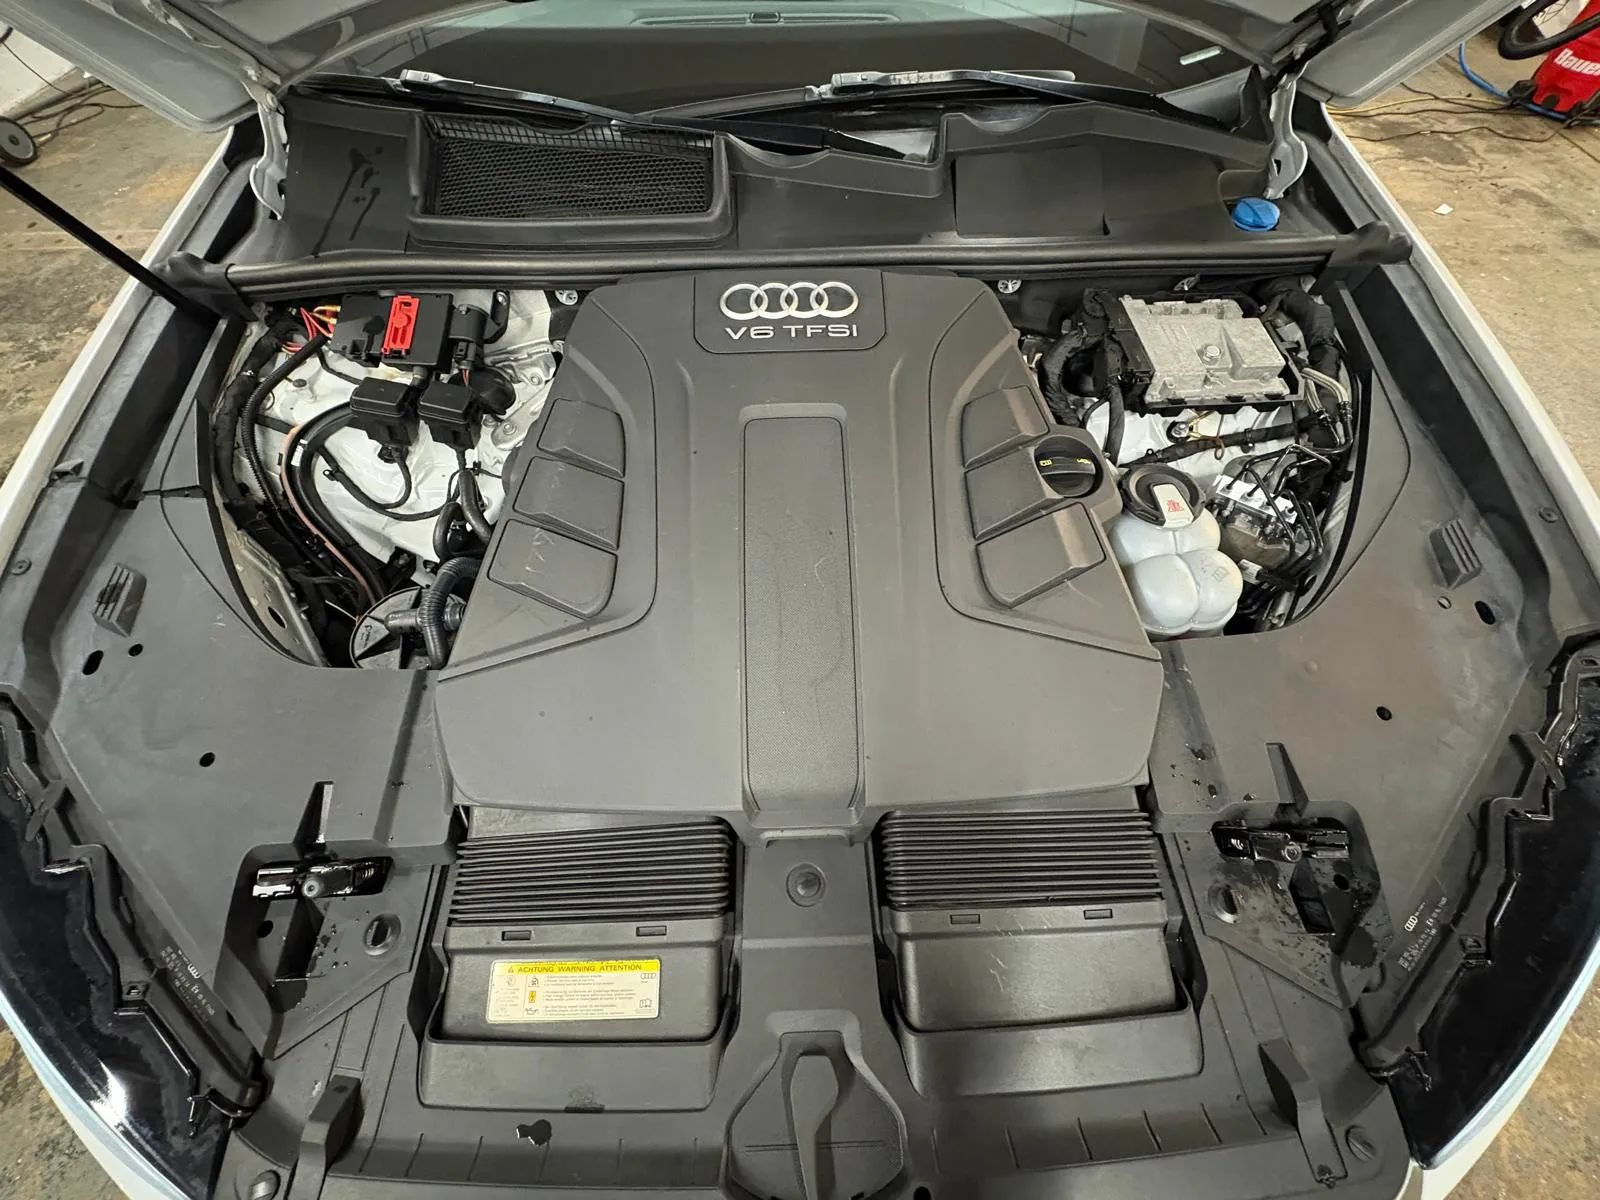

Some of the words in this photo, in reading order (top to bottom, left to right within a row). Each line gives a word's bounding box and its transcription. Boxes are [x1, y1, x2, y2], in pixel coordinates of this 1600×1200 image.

[724, 325, 775, 340] V6
[782, 323, 858, 338] TFSI
[518, 965, 554, 973] ACHTUNG
[558, 965, 596, 973] WARNING
[599, 963, 642, 972] ATTENTION
